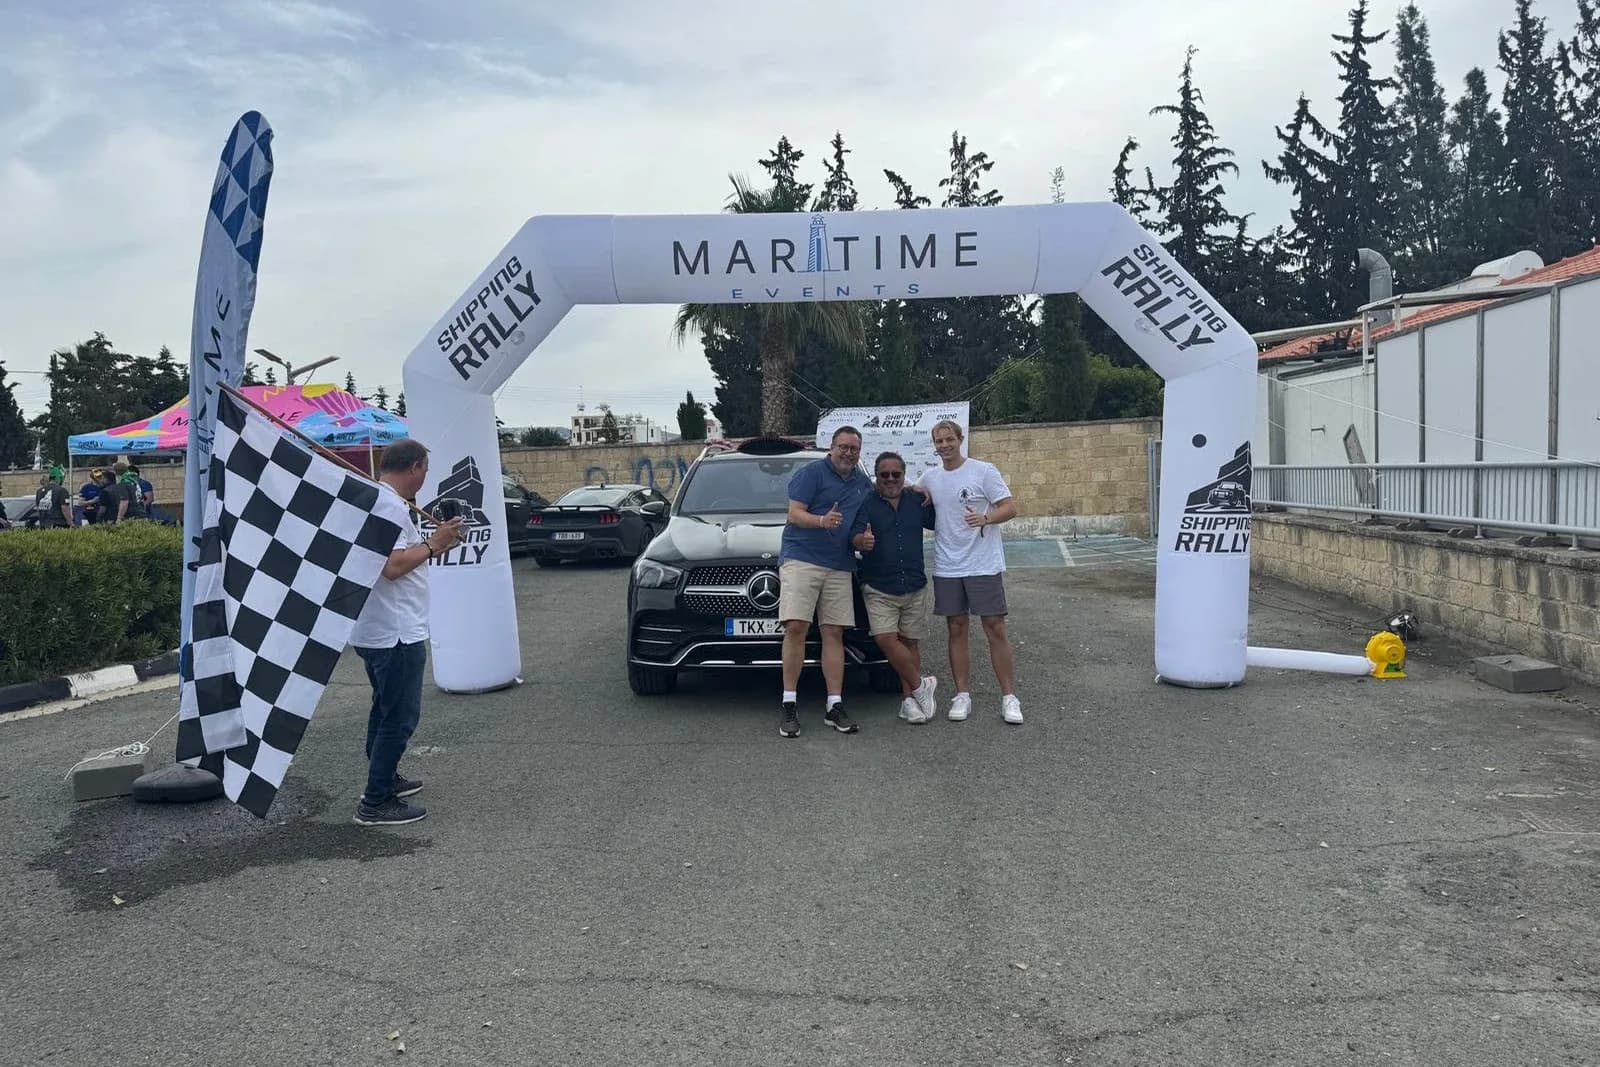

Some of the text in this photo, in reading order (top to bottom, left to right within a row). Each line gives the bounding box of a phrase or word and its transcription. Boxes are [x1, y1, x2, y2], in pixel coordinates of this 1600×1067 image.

[672, 231, 978, 276] MARITIME
[437, 255, 522, 352] SHIPPING
[732, 284, 920, 299] EVENTS
[1100, 256, 1215, 351] RALLY
[1133, 244, 1228, 333] SHIPPING
[448, 269, 542, 381] RALLY
[881, 419, 920, 428] RALLY
[1174, 532, 1250, 553] RALLY
[738, 620, 765, 634] TKX
